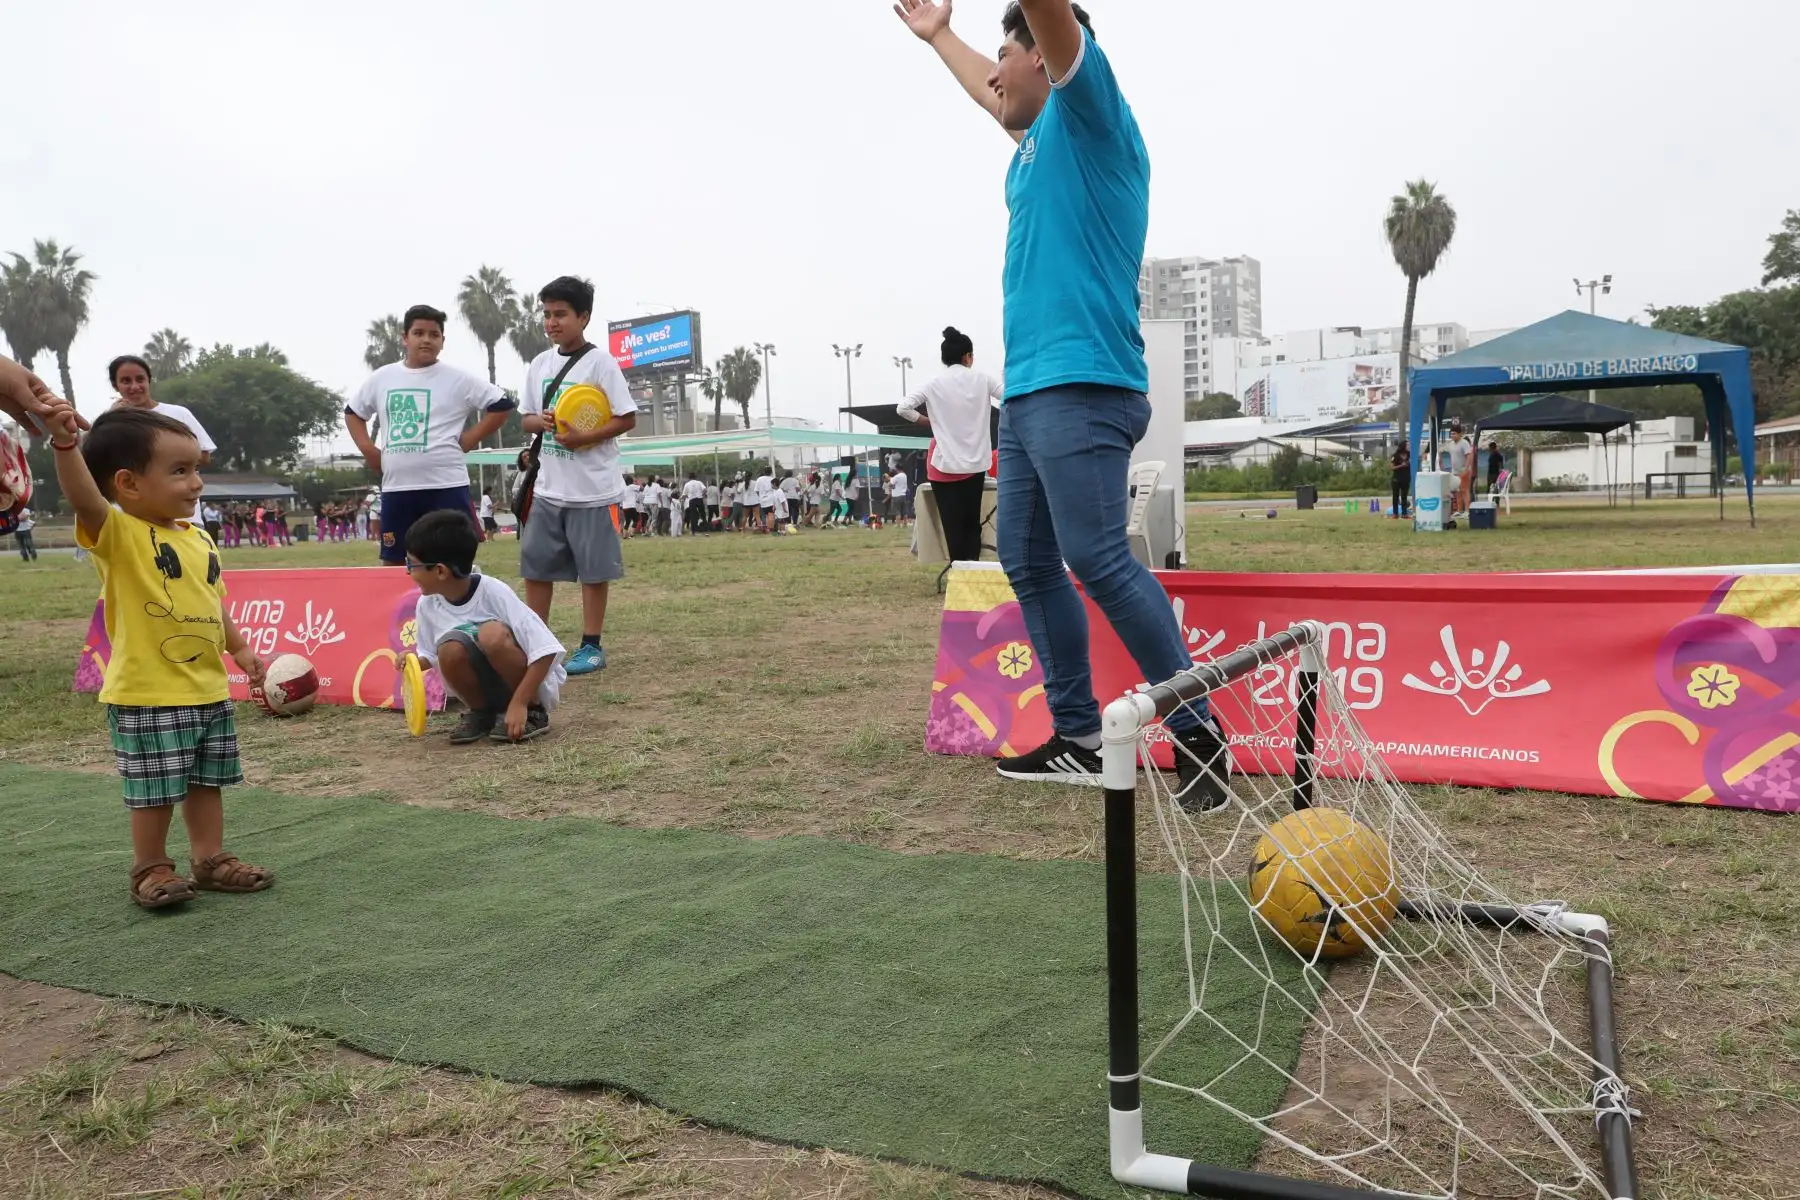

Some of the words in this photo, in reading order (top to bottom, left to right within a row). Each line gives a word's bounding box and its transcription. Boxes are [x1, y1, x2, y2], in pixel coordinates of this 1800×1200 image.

[620, 333, 643, 353] ¿Me
[645, 324, 671, 344] ves?
[1582, 360, 1603, 376] DE
[1608, 355, 1697, 375] BARRANCO
[390, 394, 418, 412] BA
[390, 422, 419, 441] CO
